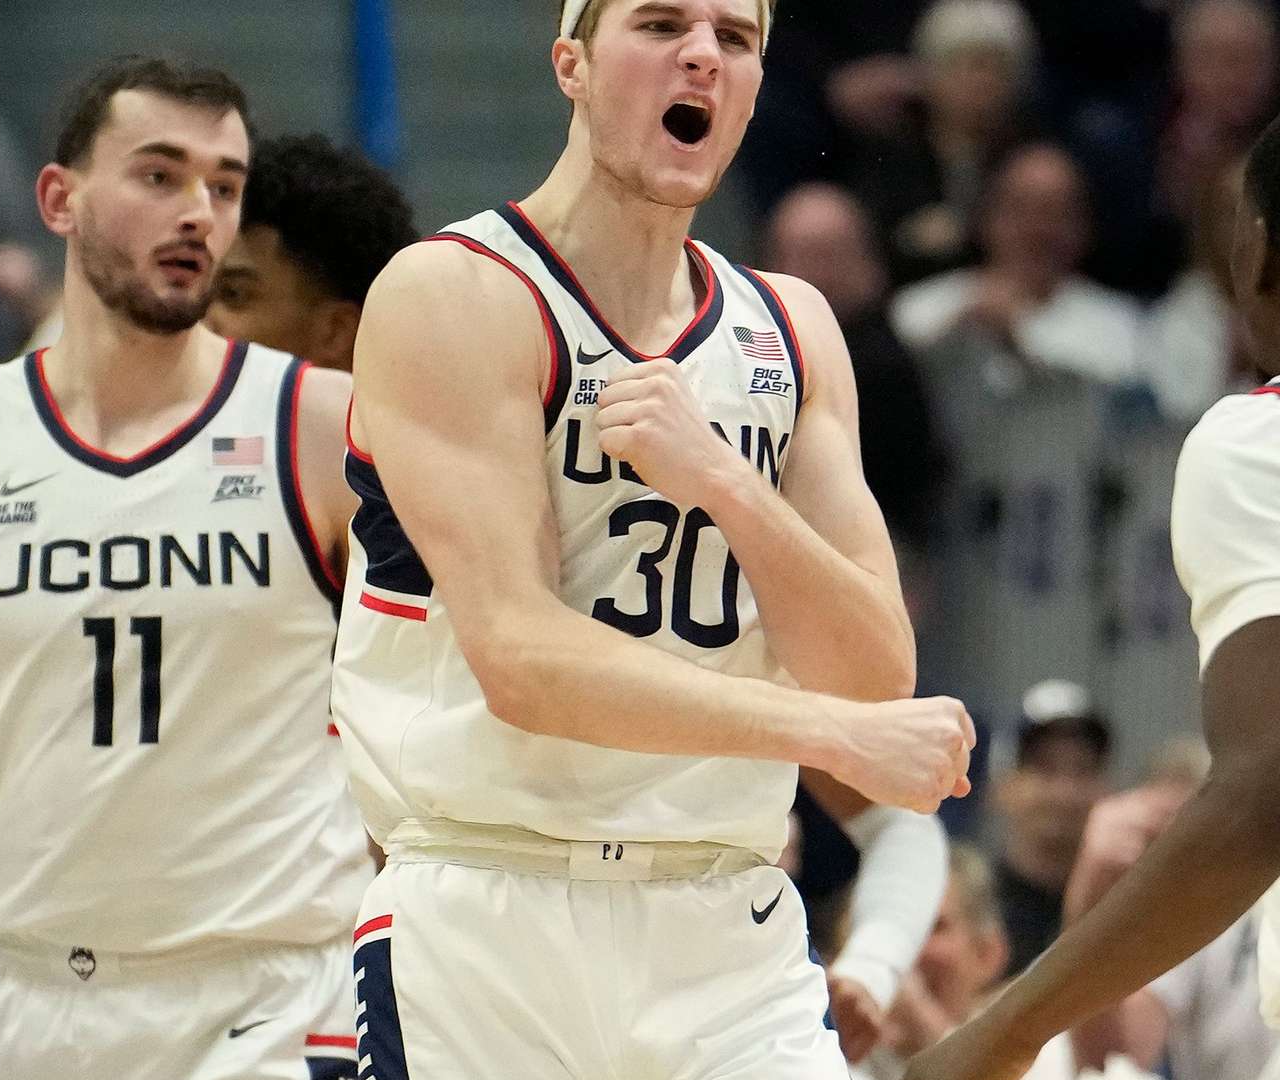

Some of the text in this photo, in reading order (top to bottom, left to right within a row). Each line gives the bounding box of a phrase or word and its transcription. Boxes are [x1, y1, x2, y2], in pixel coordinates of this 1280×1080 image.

[753, 367, 783, 380] BIG
[578, 378, 597, 392] BE
[750, 378, 793, 393] EAST
[573, 392, 599, 406] CHA
[591, 499, 740, 649] 30
[82, 615, 163, 747] 11
